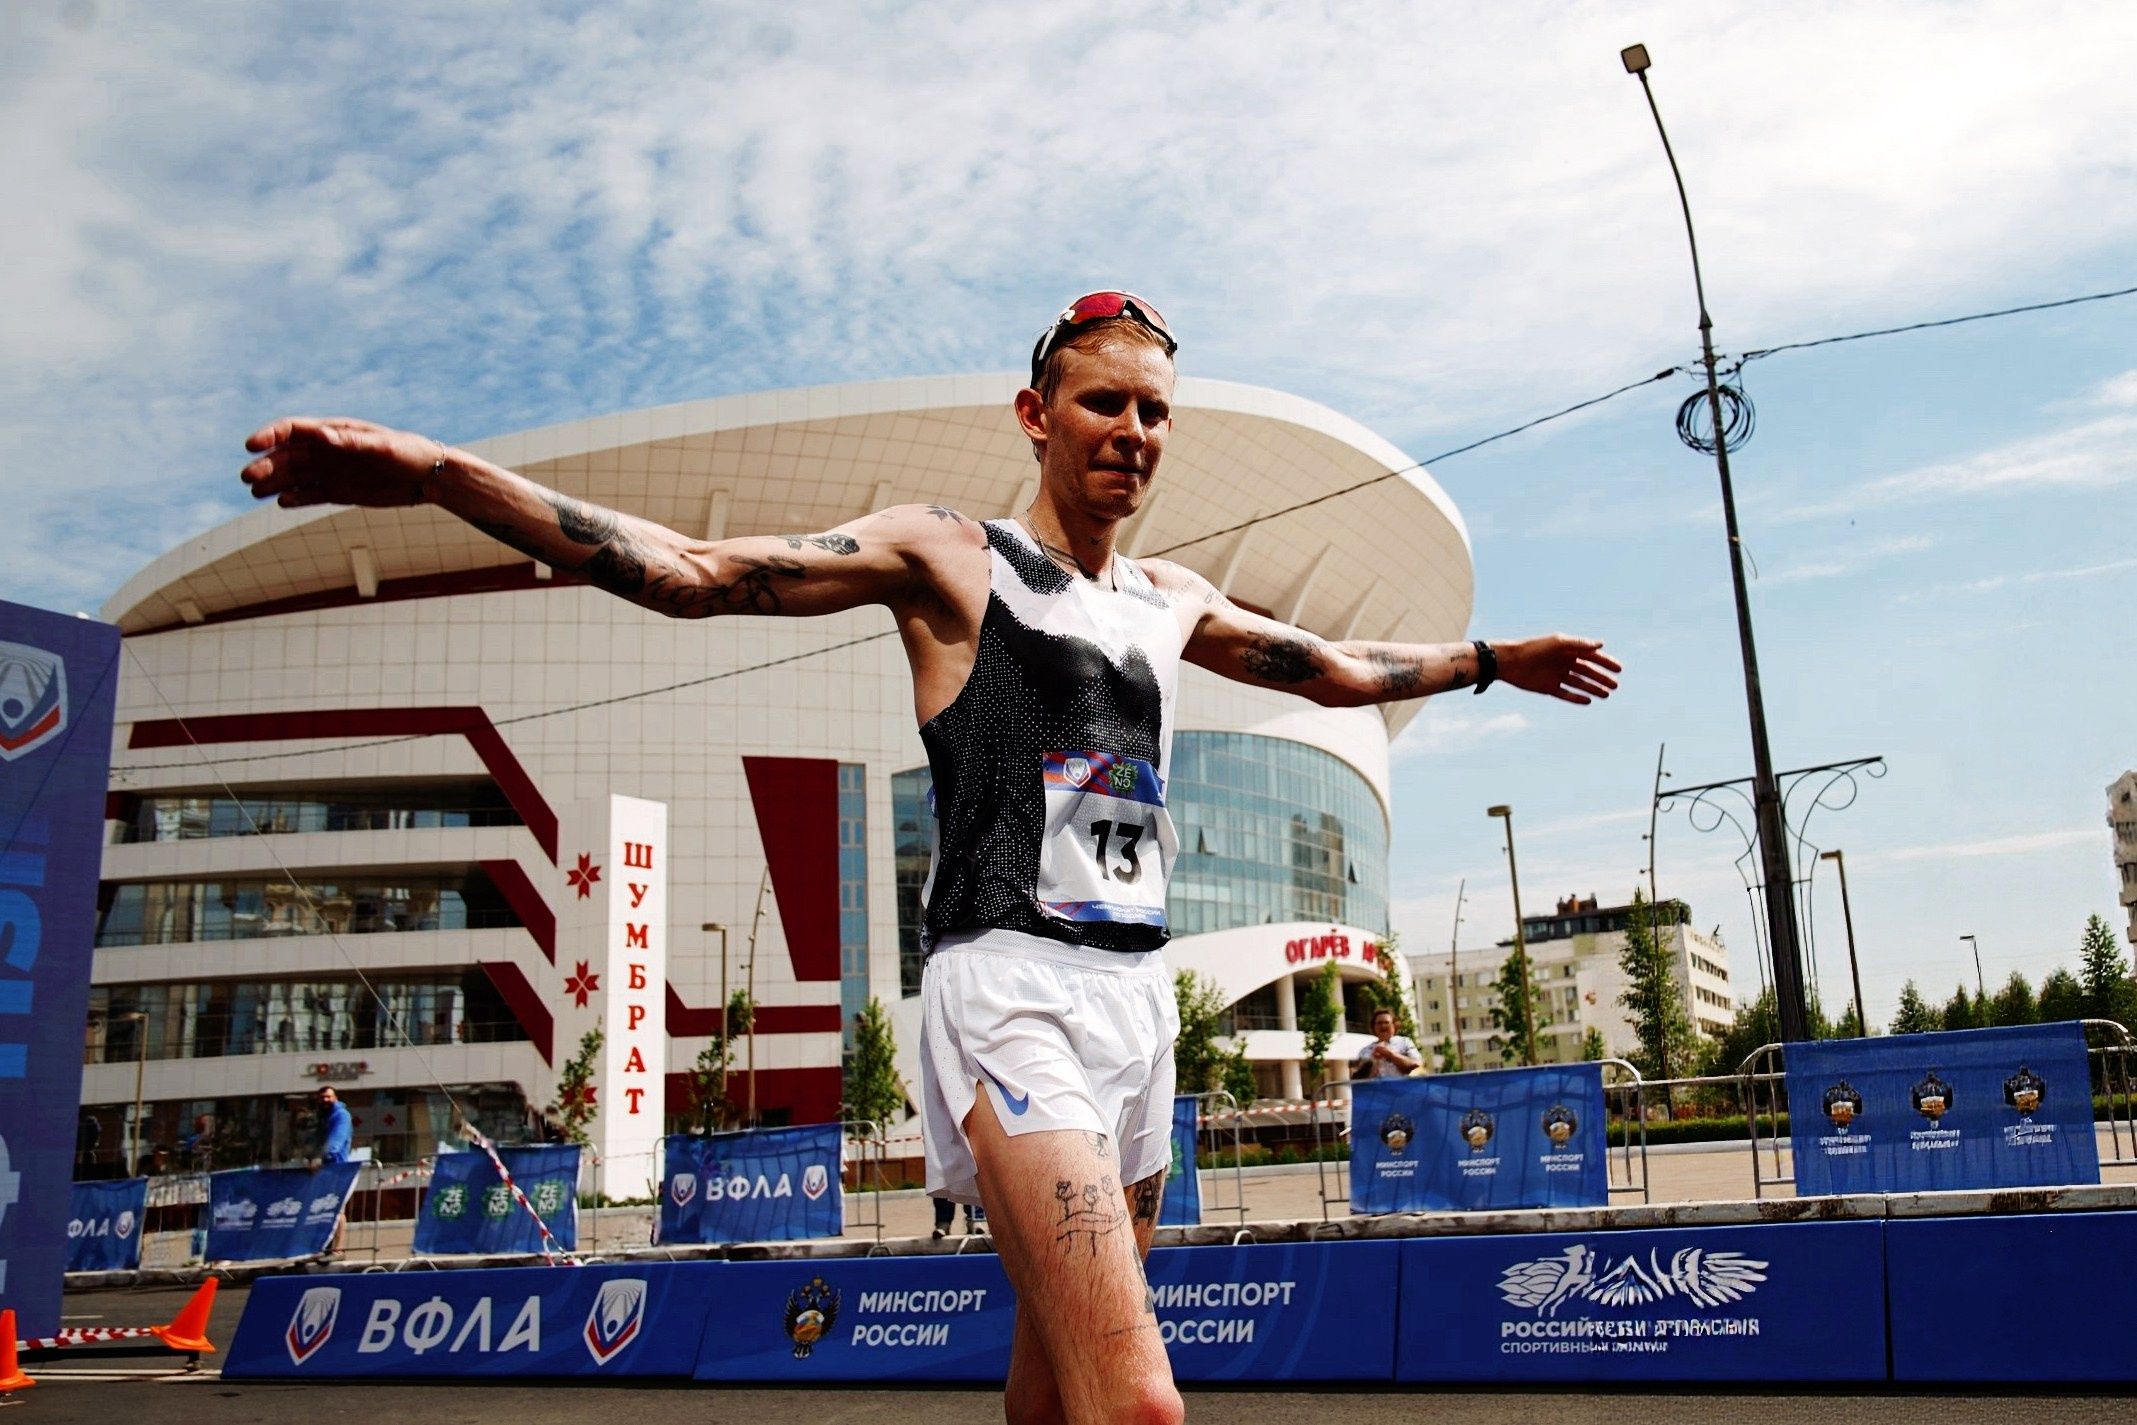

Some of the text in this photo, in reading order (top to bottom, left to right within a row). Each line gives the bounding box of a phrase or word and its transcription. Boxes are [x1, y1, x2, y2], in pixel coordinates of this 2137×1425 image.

[1090, 819, 1144, 885] 13
[624, 842, 653, 1114] ШУМБРАТ
[1380, 1169, 1414, 1178] РОССИИ
[1463, 1167, 1496, 1176] РОССИИ
[1546, 1163, 1580, 1172] РОССИИ
[706, 1173, 793, 1201] ВФЛА
[67, 1218, 110, 1238] ФЛА
[858, 1289, 987, 1313] МИНСПОРТ
[1149, 1281, 1296, 1308] МИНСПОРТ
[357, 1295, 541, 1355] ВФЛА
[851, 1324, 949, 1347] РОССИИ
[1160, 1319, 1255, 1344] ОССИИ
